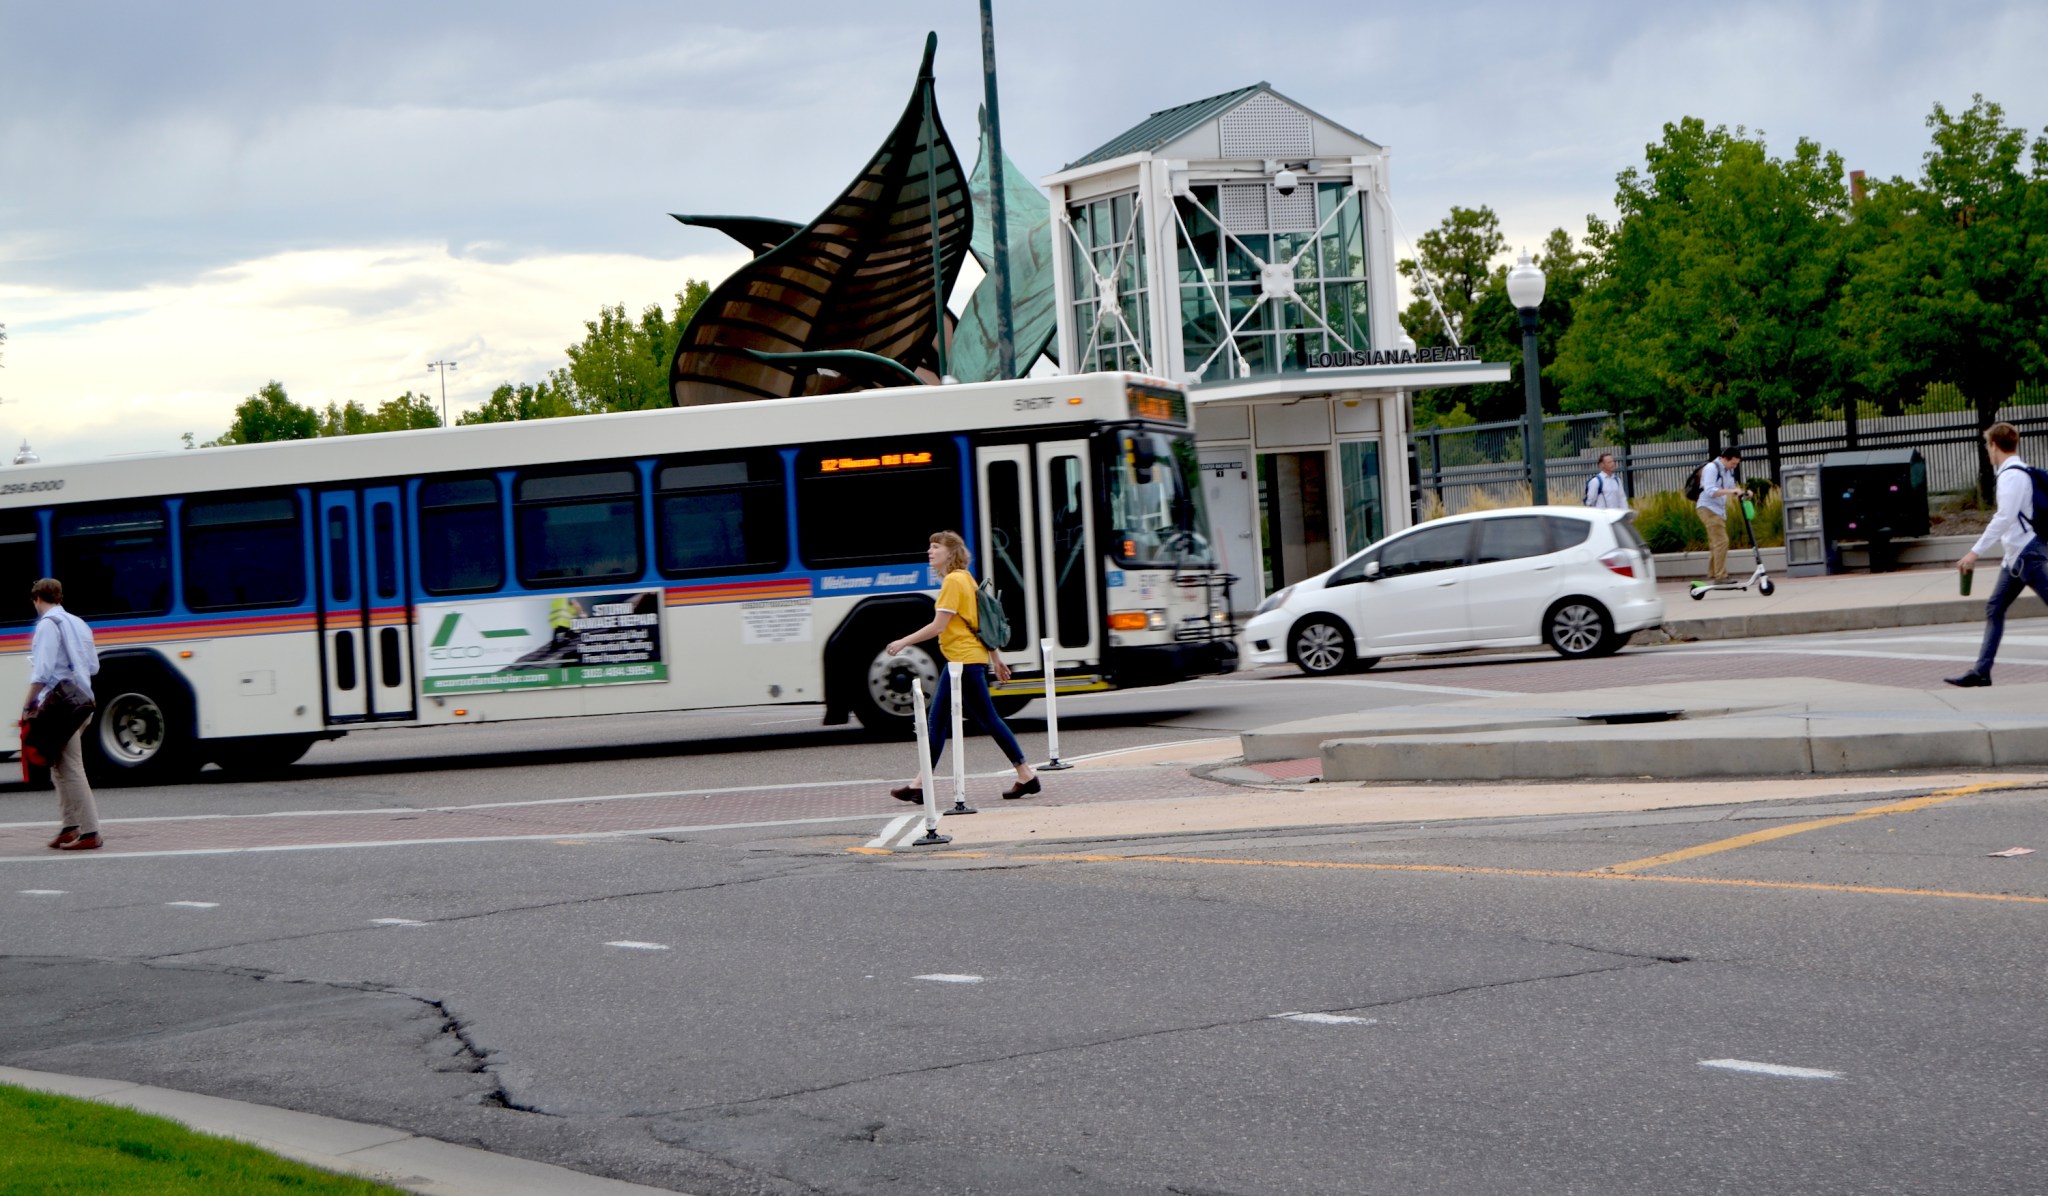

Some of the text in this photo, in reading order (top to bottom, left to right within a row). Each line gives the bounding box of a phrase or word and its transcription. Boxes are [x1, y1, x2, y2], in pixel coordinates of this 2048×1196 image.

[0, 479, 65, 495] .299.6000
[821, 575, 873, 590] Welcome
[873, 570, 920, 587] Aboard
[592, 602, 633, 617] STORM
[570, 613, 658, 631] DAMAGE REPAIR
[581, 630, 628, 643] Commercial
[577, 639, 654, 653] Residential Roofing
[582, 651, 650, 663] Free Inspections
